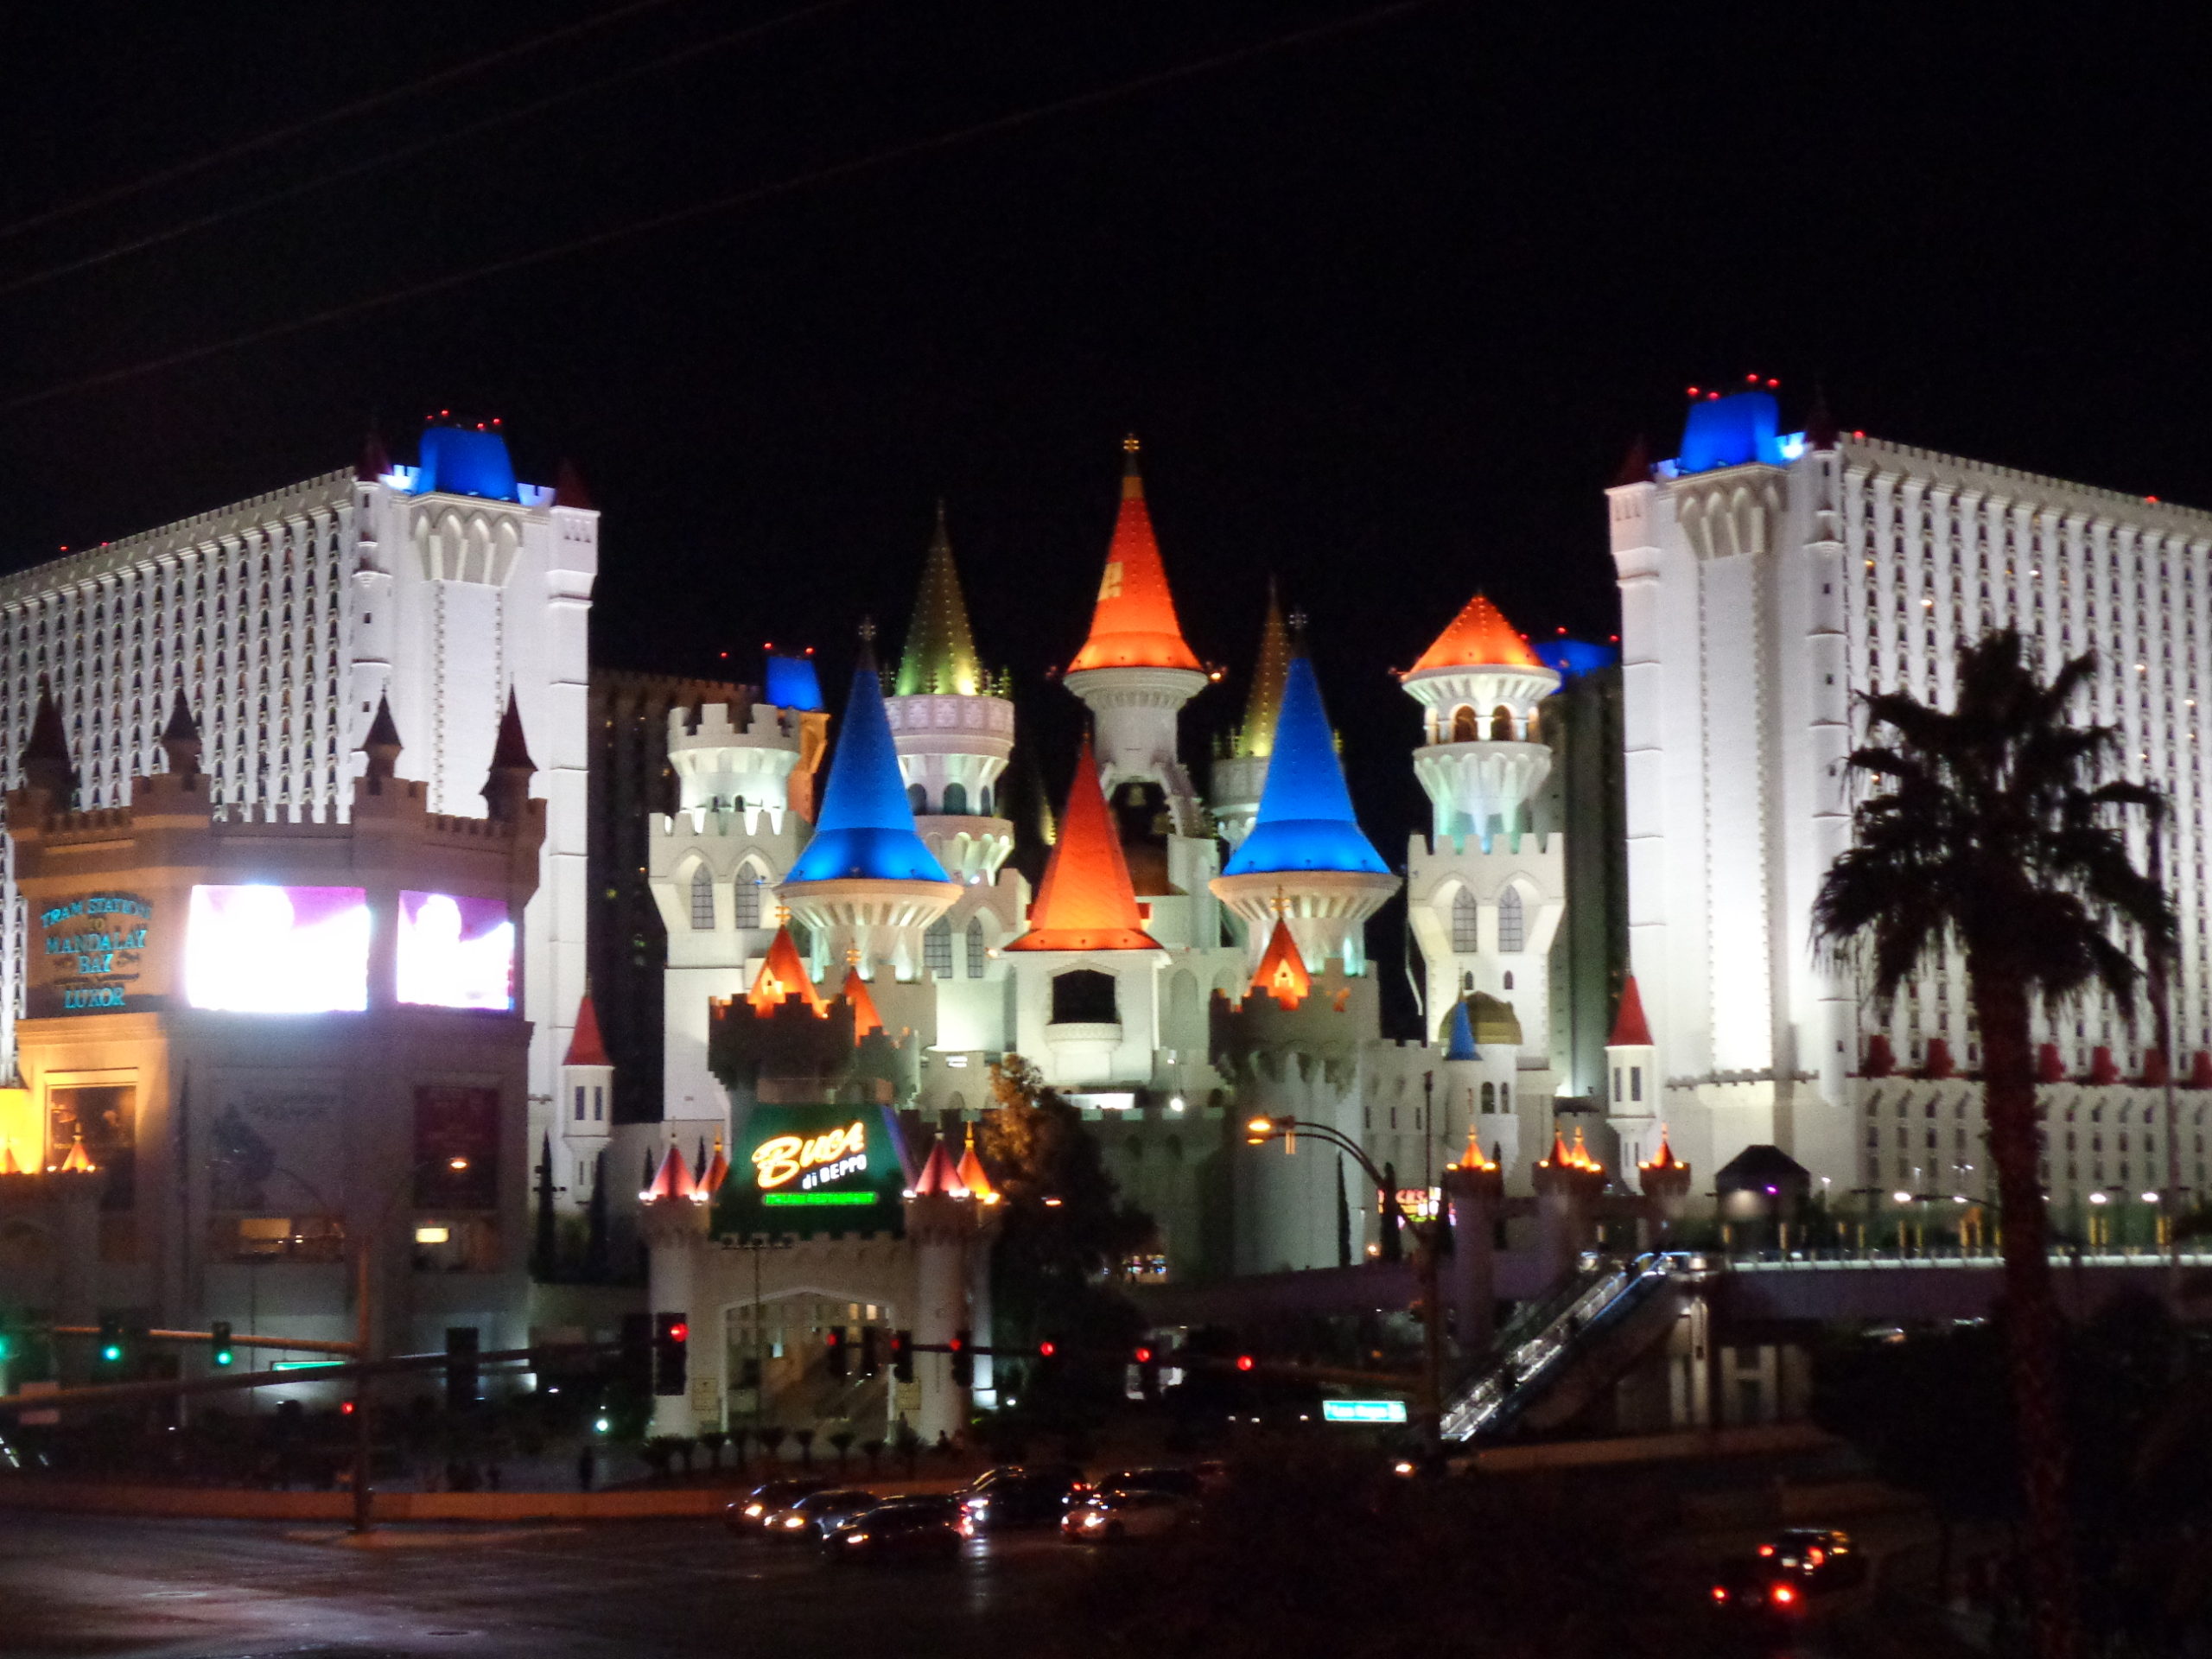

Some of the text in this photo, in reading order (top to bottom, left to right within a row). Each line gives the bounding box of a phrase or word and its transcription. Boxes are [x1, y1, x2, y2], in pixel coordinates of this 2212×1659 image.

[41, 897, 152, 928] TRAM STATION
[45, 929, 148, 955] MANDALAY
[77, 953, 114, 974] BAY
[63, 987, 125, 1009] LUXOR
[819, 1154, 868, 1183] BEPPO
